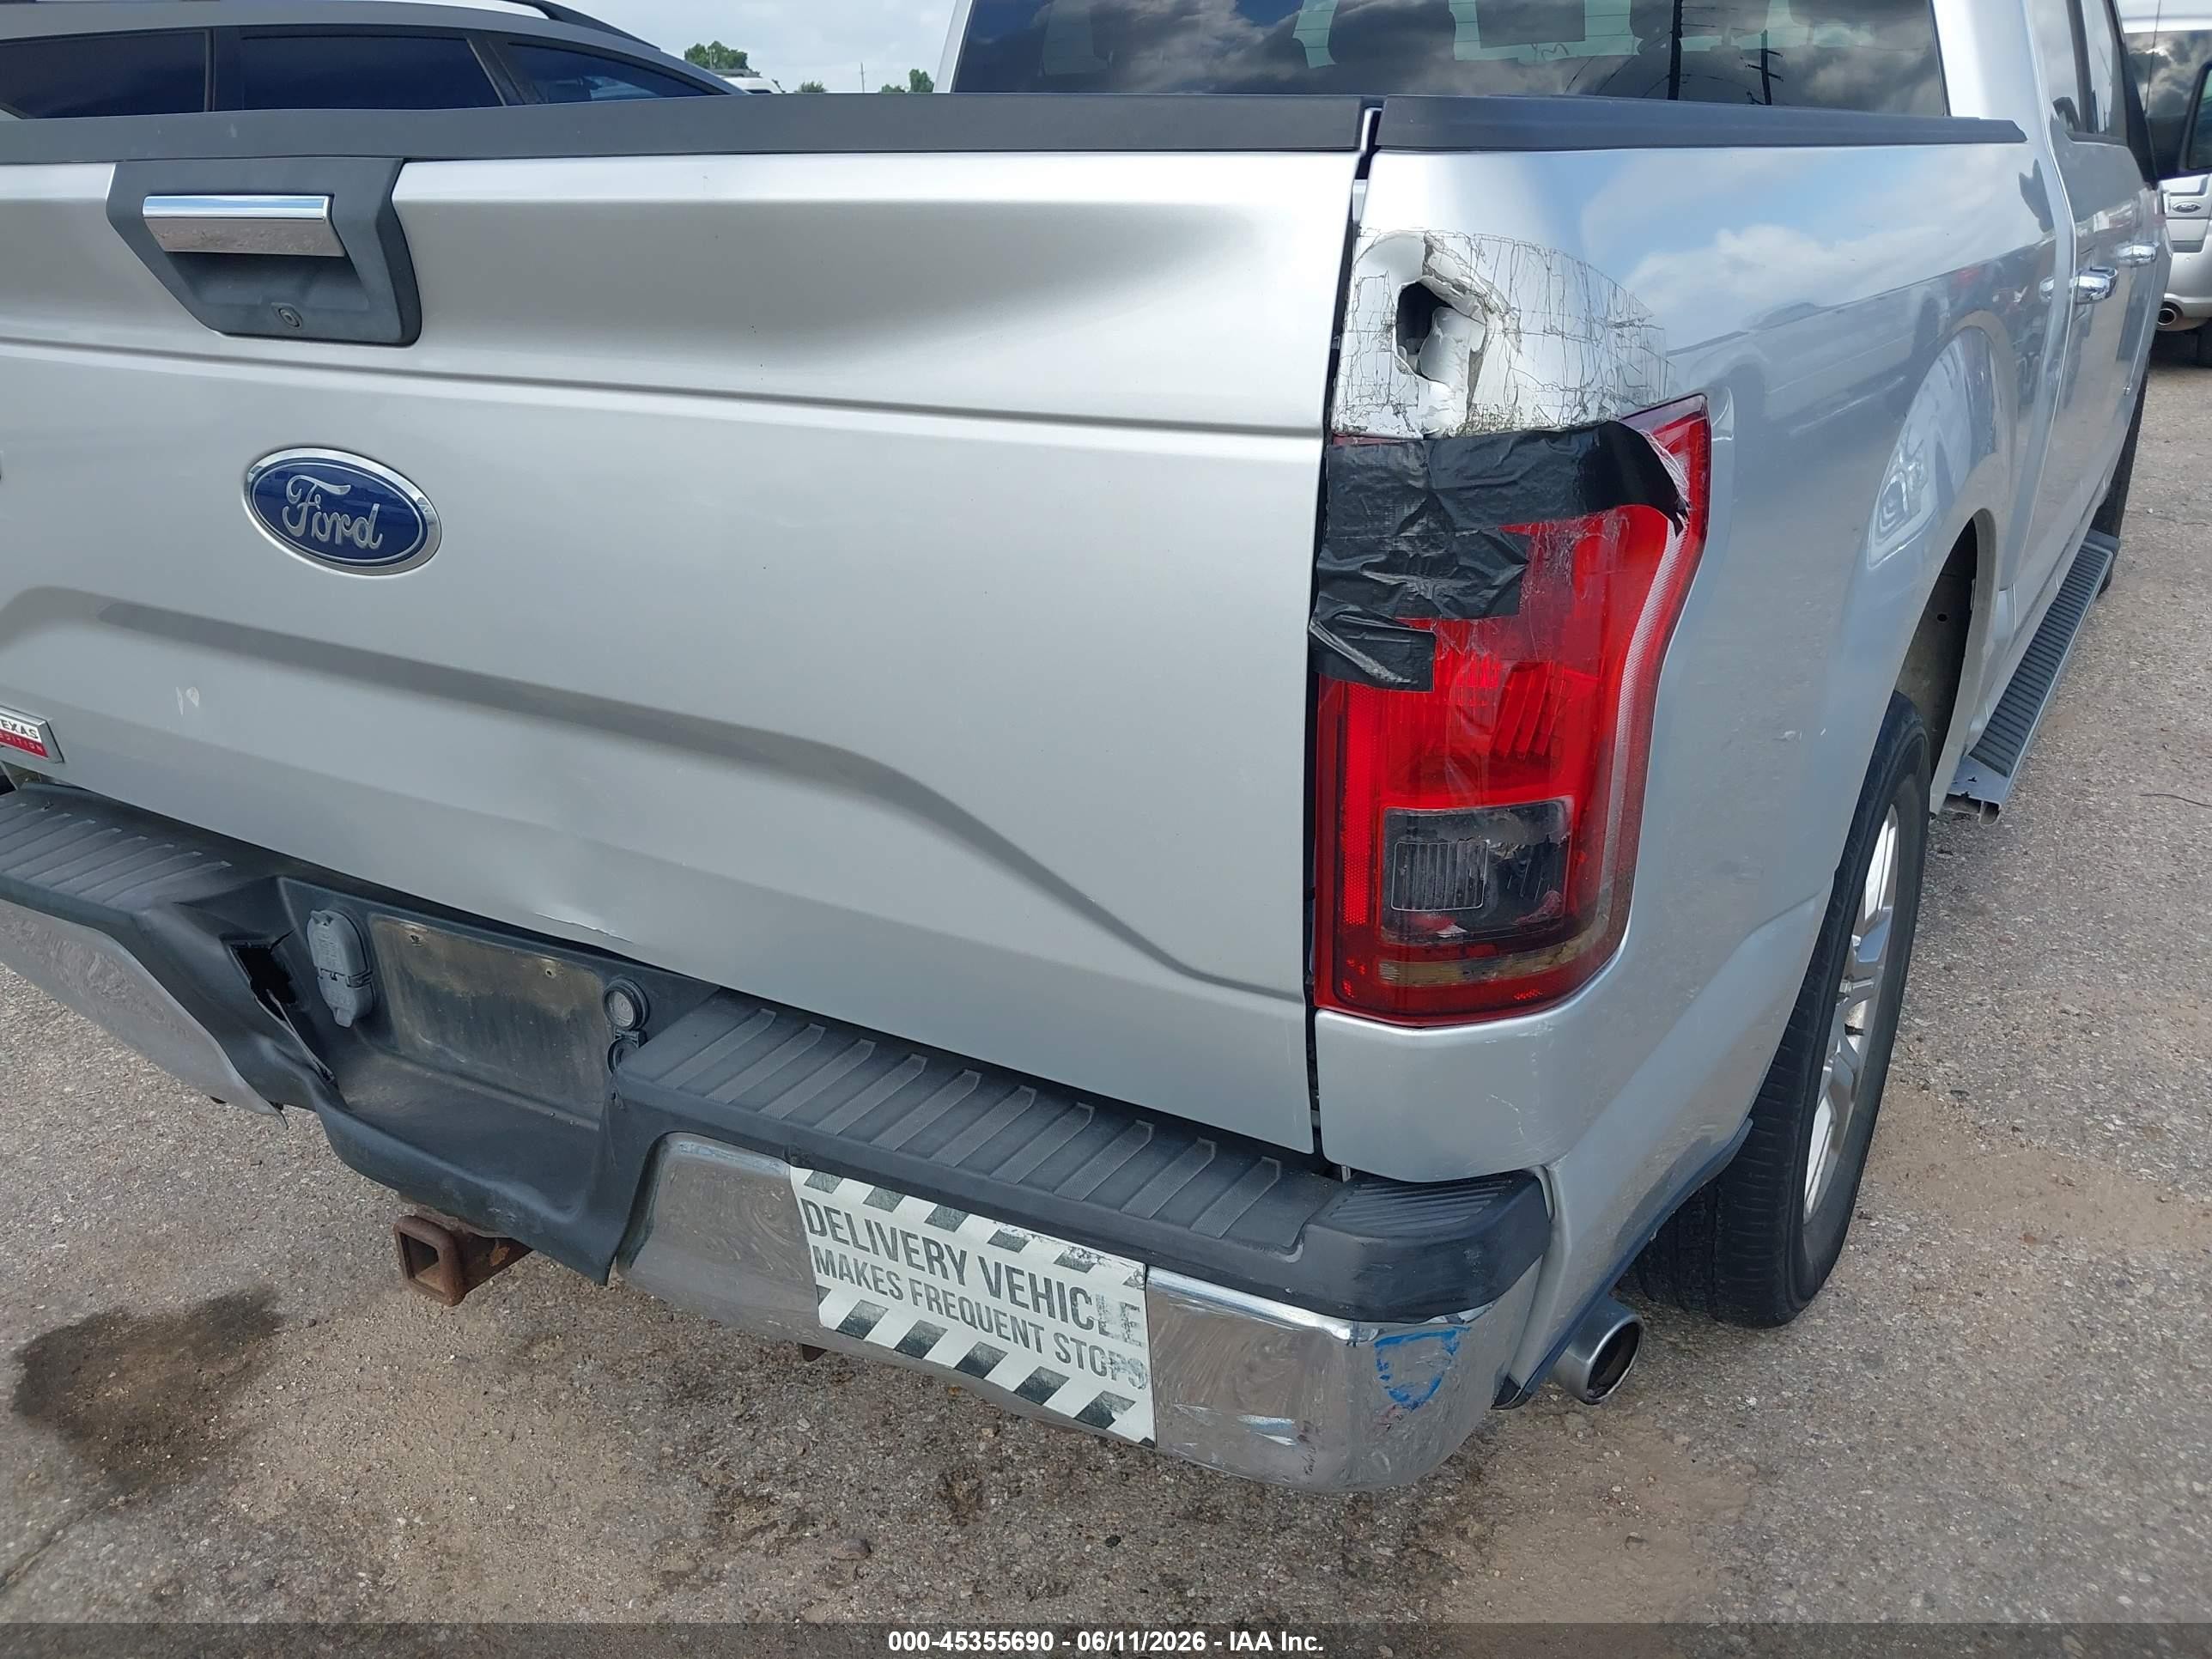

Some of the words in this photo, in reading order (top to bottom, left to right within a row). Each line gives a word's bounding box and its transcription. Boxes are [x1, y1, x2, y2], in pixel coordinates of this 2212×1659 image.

[283, 475, 383, 550] Ford
[0, 719, 39, 739] EXAS
[799, 1198, 968, 1286] DELIVERY
[977, 1255, 1142, 1347] VEHICLE
[811, 1244, 904, 1301] MAKES
[908, 1277, 1045, 1354] FREQUENT
